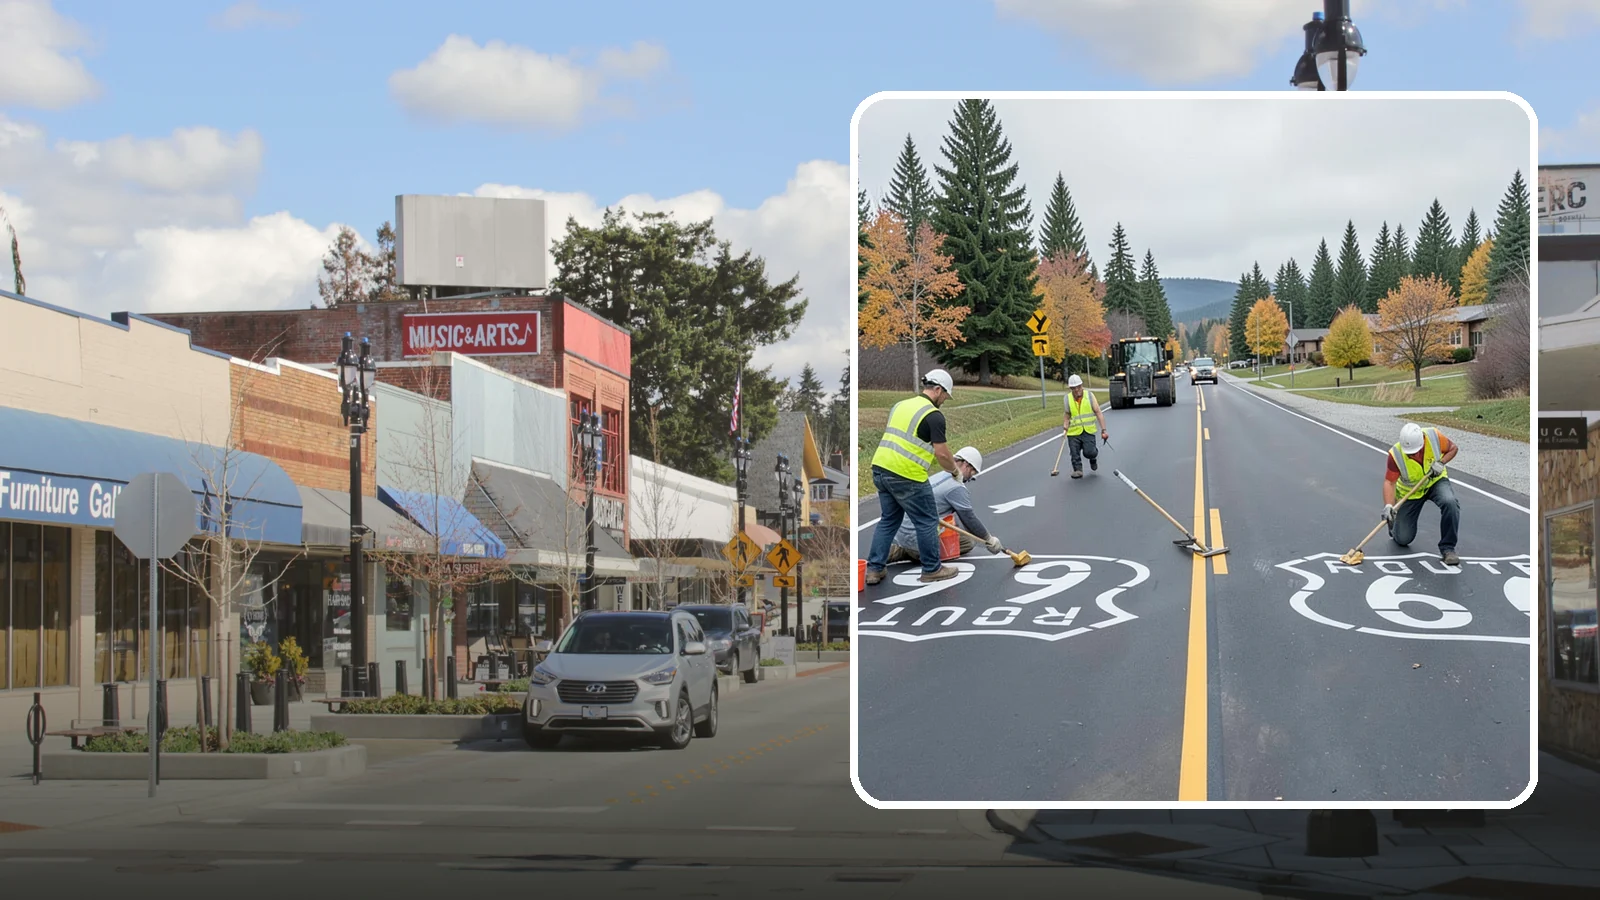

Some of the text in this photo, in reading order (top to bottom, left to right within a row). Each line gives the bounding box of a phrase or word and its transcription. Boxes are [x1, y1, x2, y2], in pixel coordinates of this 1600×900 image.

[1541, 428, 1576, 437] UGA
[0, 471, 122, 519] Furniture Gal
[453, 563, 479, 574] SUSHI
[858, 606, 1082, 626] ROUT
